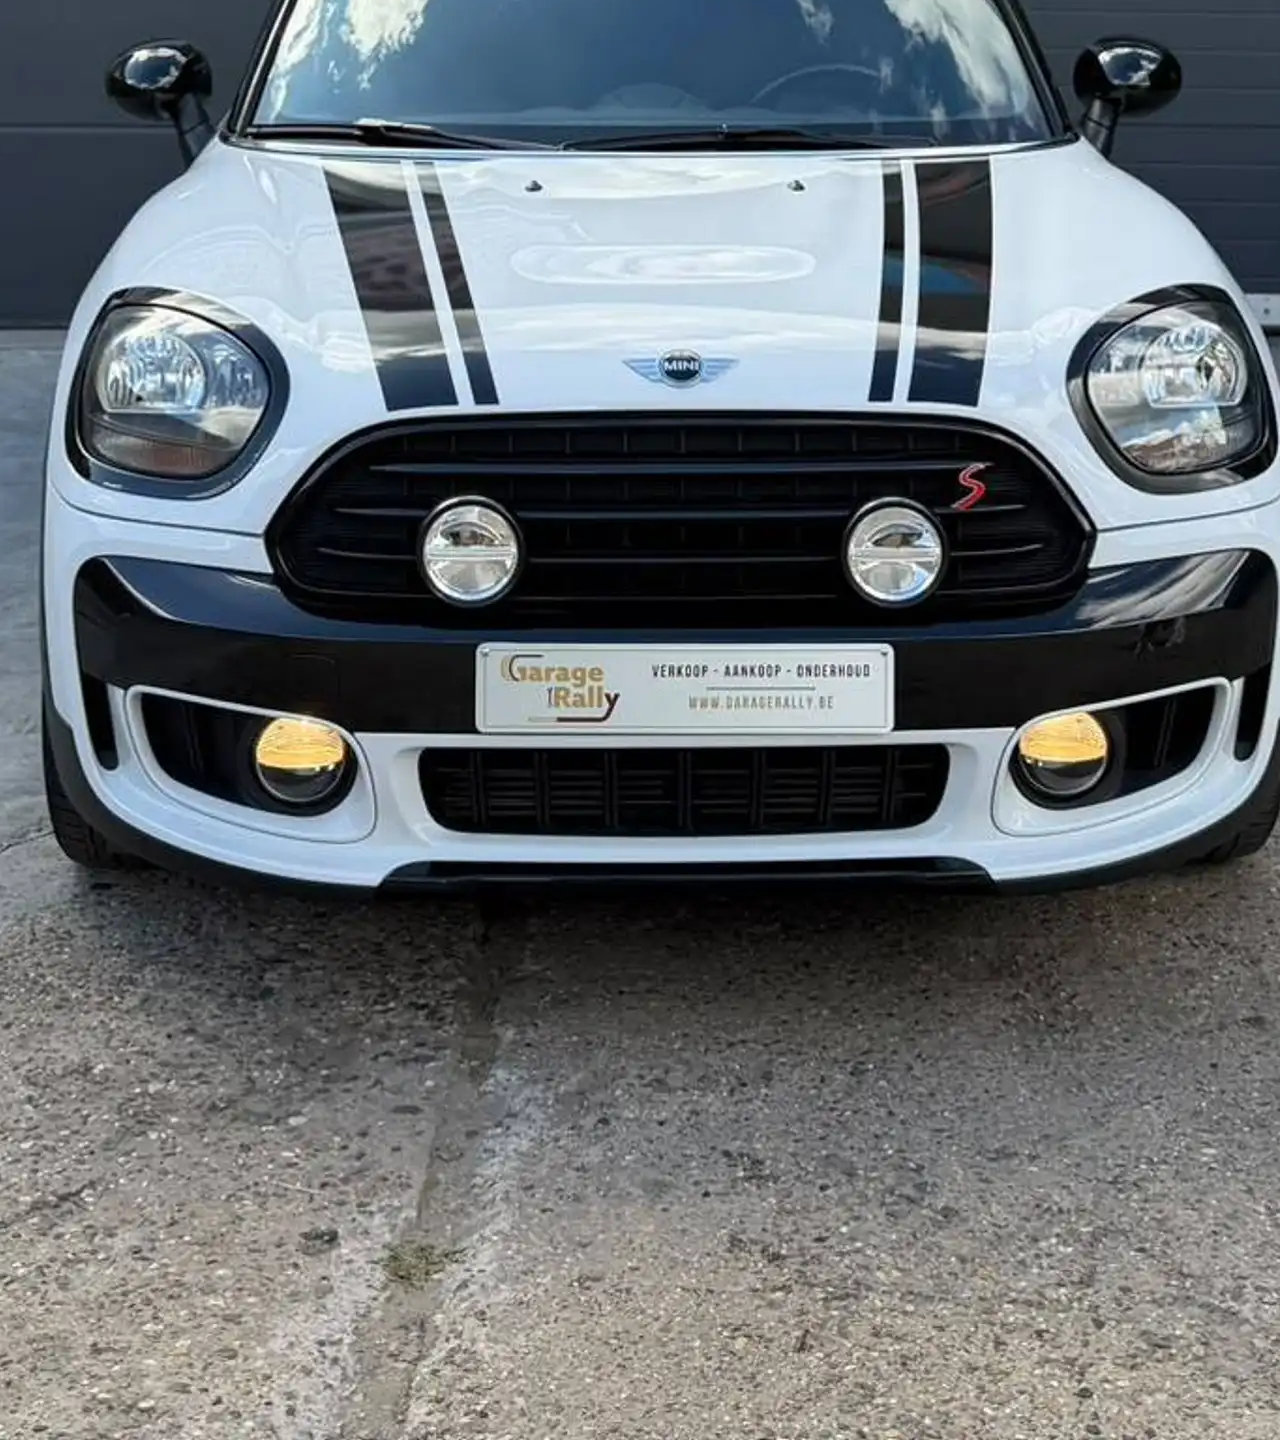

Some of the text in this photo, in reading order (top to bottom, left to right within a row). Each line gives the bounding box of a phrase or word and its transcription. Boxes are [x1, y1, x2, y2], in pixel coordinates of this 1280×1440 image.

[664, 360, 699, 371] MINI
[949, 462, 987, 511] S
[501, 654, 604, 687] Garage
[651, 663, 709, 678] VERKOOP
[724, 663, 782, 678] AANKOOP
[797, 663, 870, 678] ONDERHOUD
[553, 686, 620, 722] Rally
